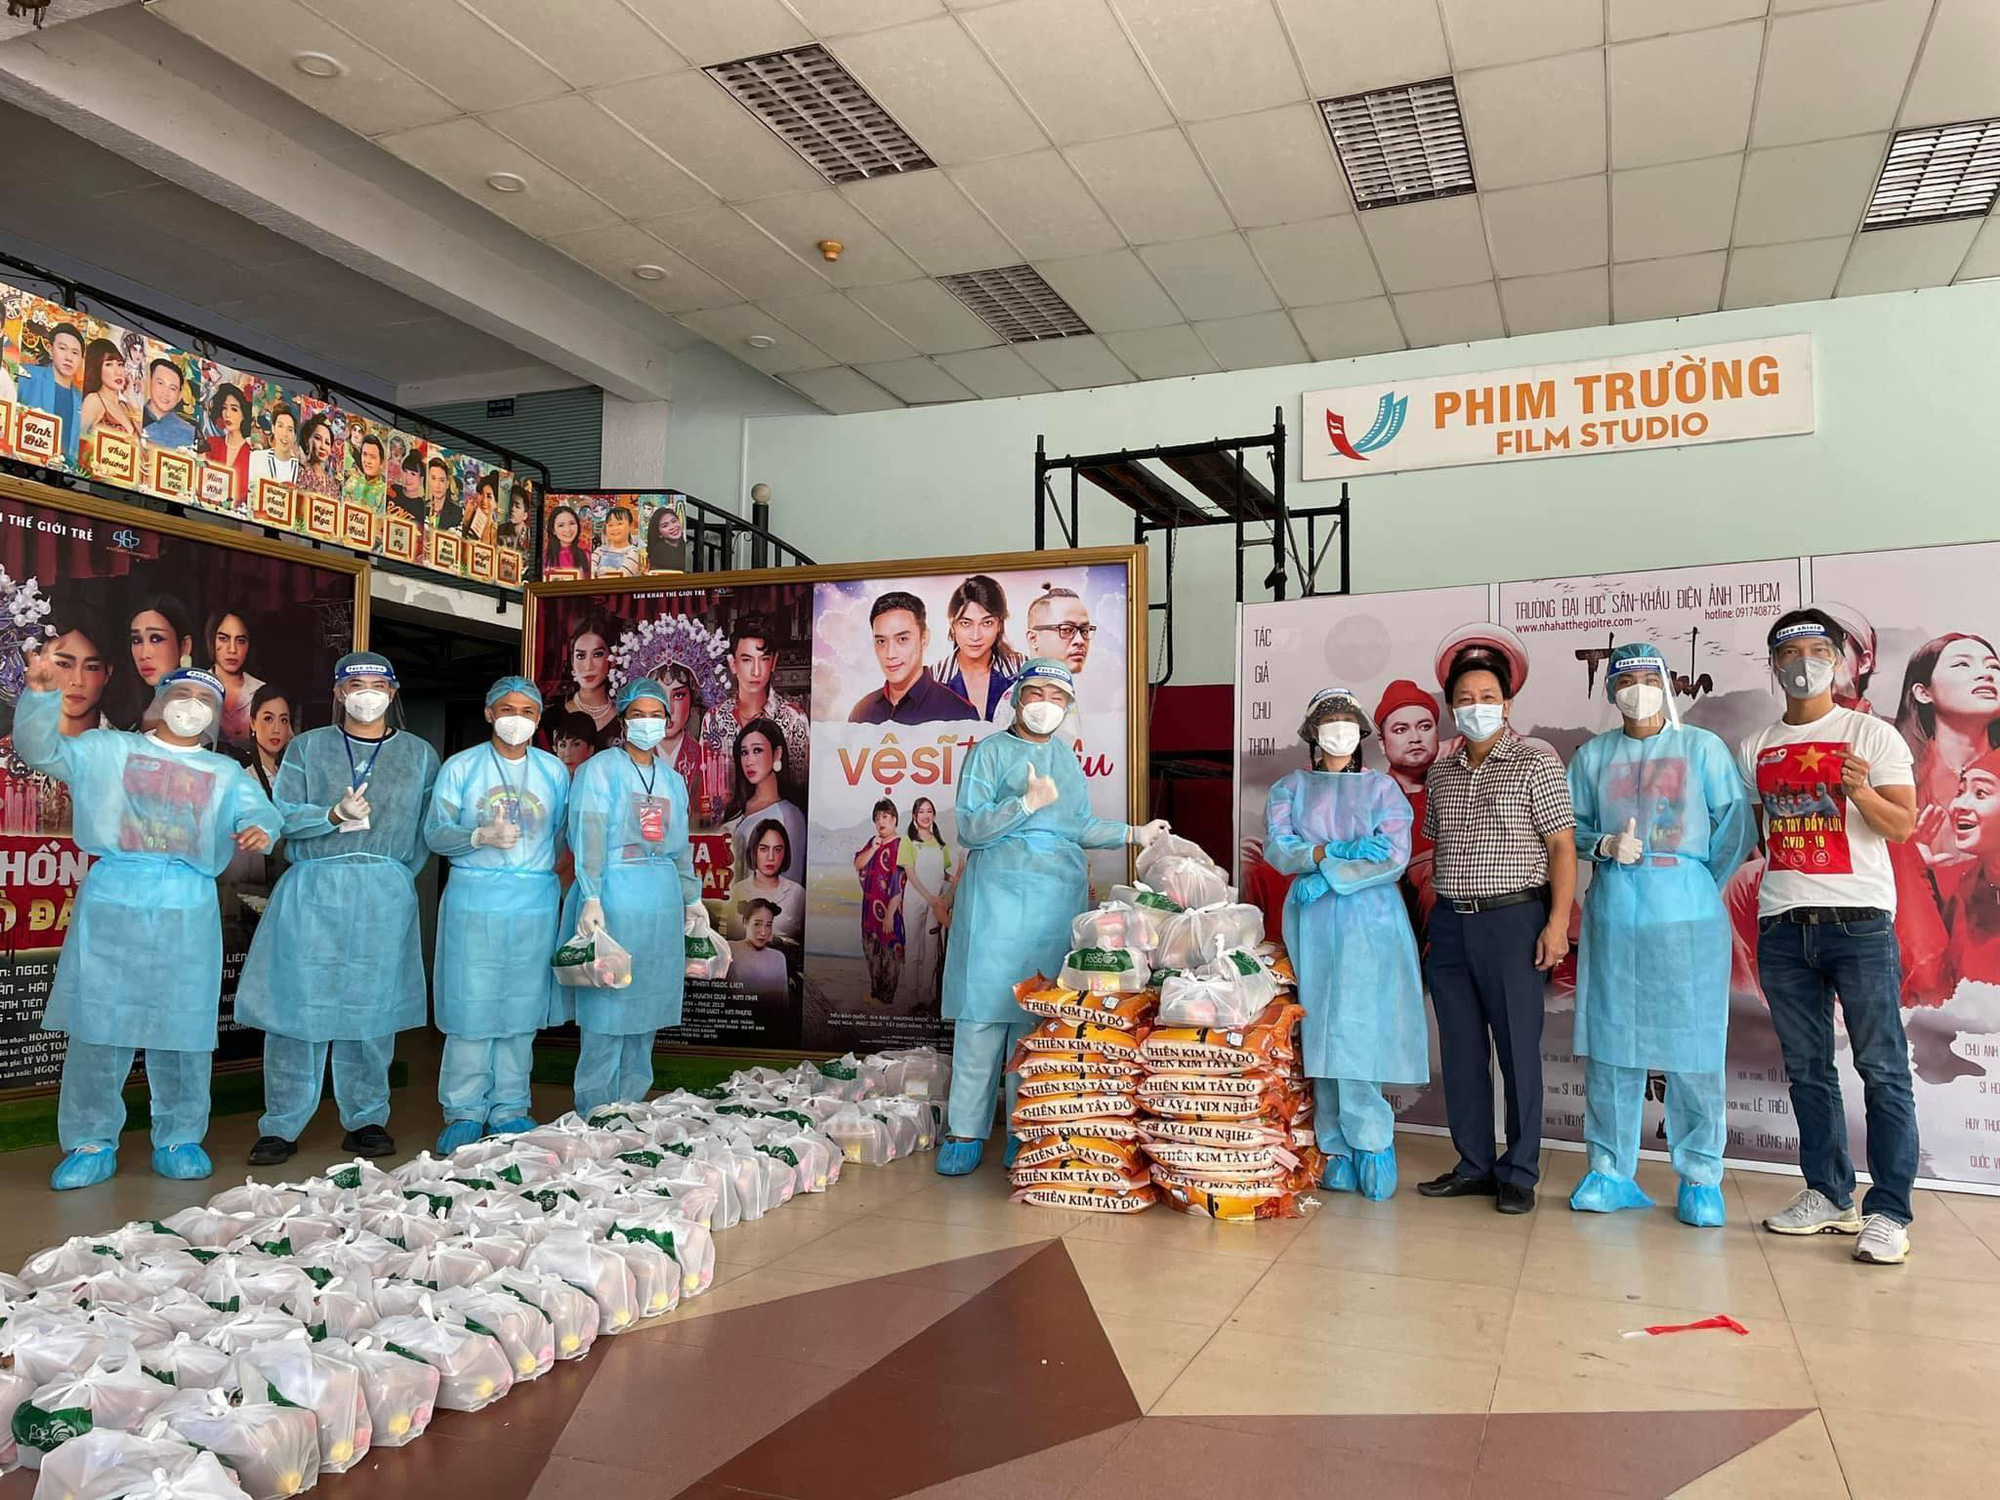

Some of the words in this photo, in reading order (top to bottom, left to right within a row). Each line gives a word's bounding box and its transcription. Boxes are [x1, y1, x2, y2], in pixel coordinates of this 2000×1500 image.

[1435, 380, 1555, 430] PHIM
[1574, 354, 1780, 414] TRƯỜNG
[25, 422, 52, 438] Anh
[1497, 425, 1570, 455] FILM
[1580, 412, 1709, 447] STUDIO
[8, 514, 34, 528] THẾ
[37, 521, 66, 536] GIỚI
[70, 528, 93, 541] TRẺ
[1562, 598, 1579, 619] ĐẠI
[1585, 595, 1606, 617] HỌC
[1677, 586, 1702, 610] ĐIỆN
[1709, 583, 1732, 607] ẢNH
[1705, 608, 1735, 620] hotline:
[1515, 618, 1633, 633] www.nhahatthegioitre.com
[1253, 626, 1272, 648] TÁC
[1252, 701, 1271, 719] CHU
[1025, 1001, 1058, 1014] THIÊN
[1060, 1005, 1081, 1017] KIM
[1083, 1008, 1106, 1023] TÂY
[1068, 1040, 1091, 1050] KIM
[1094, 1041, 1116, 1054] TÂY
[1965, 1043, 1980, 1056] CHU
[1984, 1044, 1998, 1058] ANH
[1182, 1049, 1206, 1058] KIM
[1208, 1050, 1233, 1062] TÂY
[1061, 1064, 1084, 1074] KIM
[1087, 1062, 1111, 1074] TÂY
[1144, 1079, 1178, 1092] THIÊN
[1182, 1081, 1205, 1091] KIM
[1208, 1080, 1234, 1092] TÂY
[1059, 1103, 1083, 1115] KIM
[1086, 1102, 1111, 1113] TÂY
[1083, 1125, 1111, 1136] TÂY
[1162, 1124, 1185, 1135] TÂY
[1965, 1118, 1980, 1131] HUY
[1189, 1126, 1213, 1138] KIM
[1196, 1151, 1221, 1162] KIM
[1224, 1150, 1251, 1162] TÂY
[1051, 1171, 1074, 1181] KIM
[1076, 1169, 1100, 1182] TÂY
[1068, 1195, 1092, 1206] KIM
[1095, 1197, 1119, 1209] TÂY
